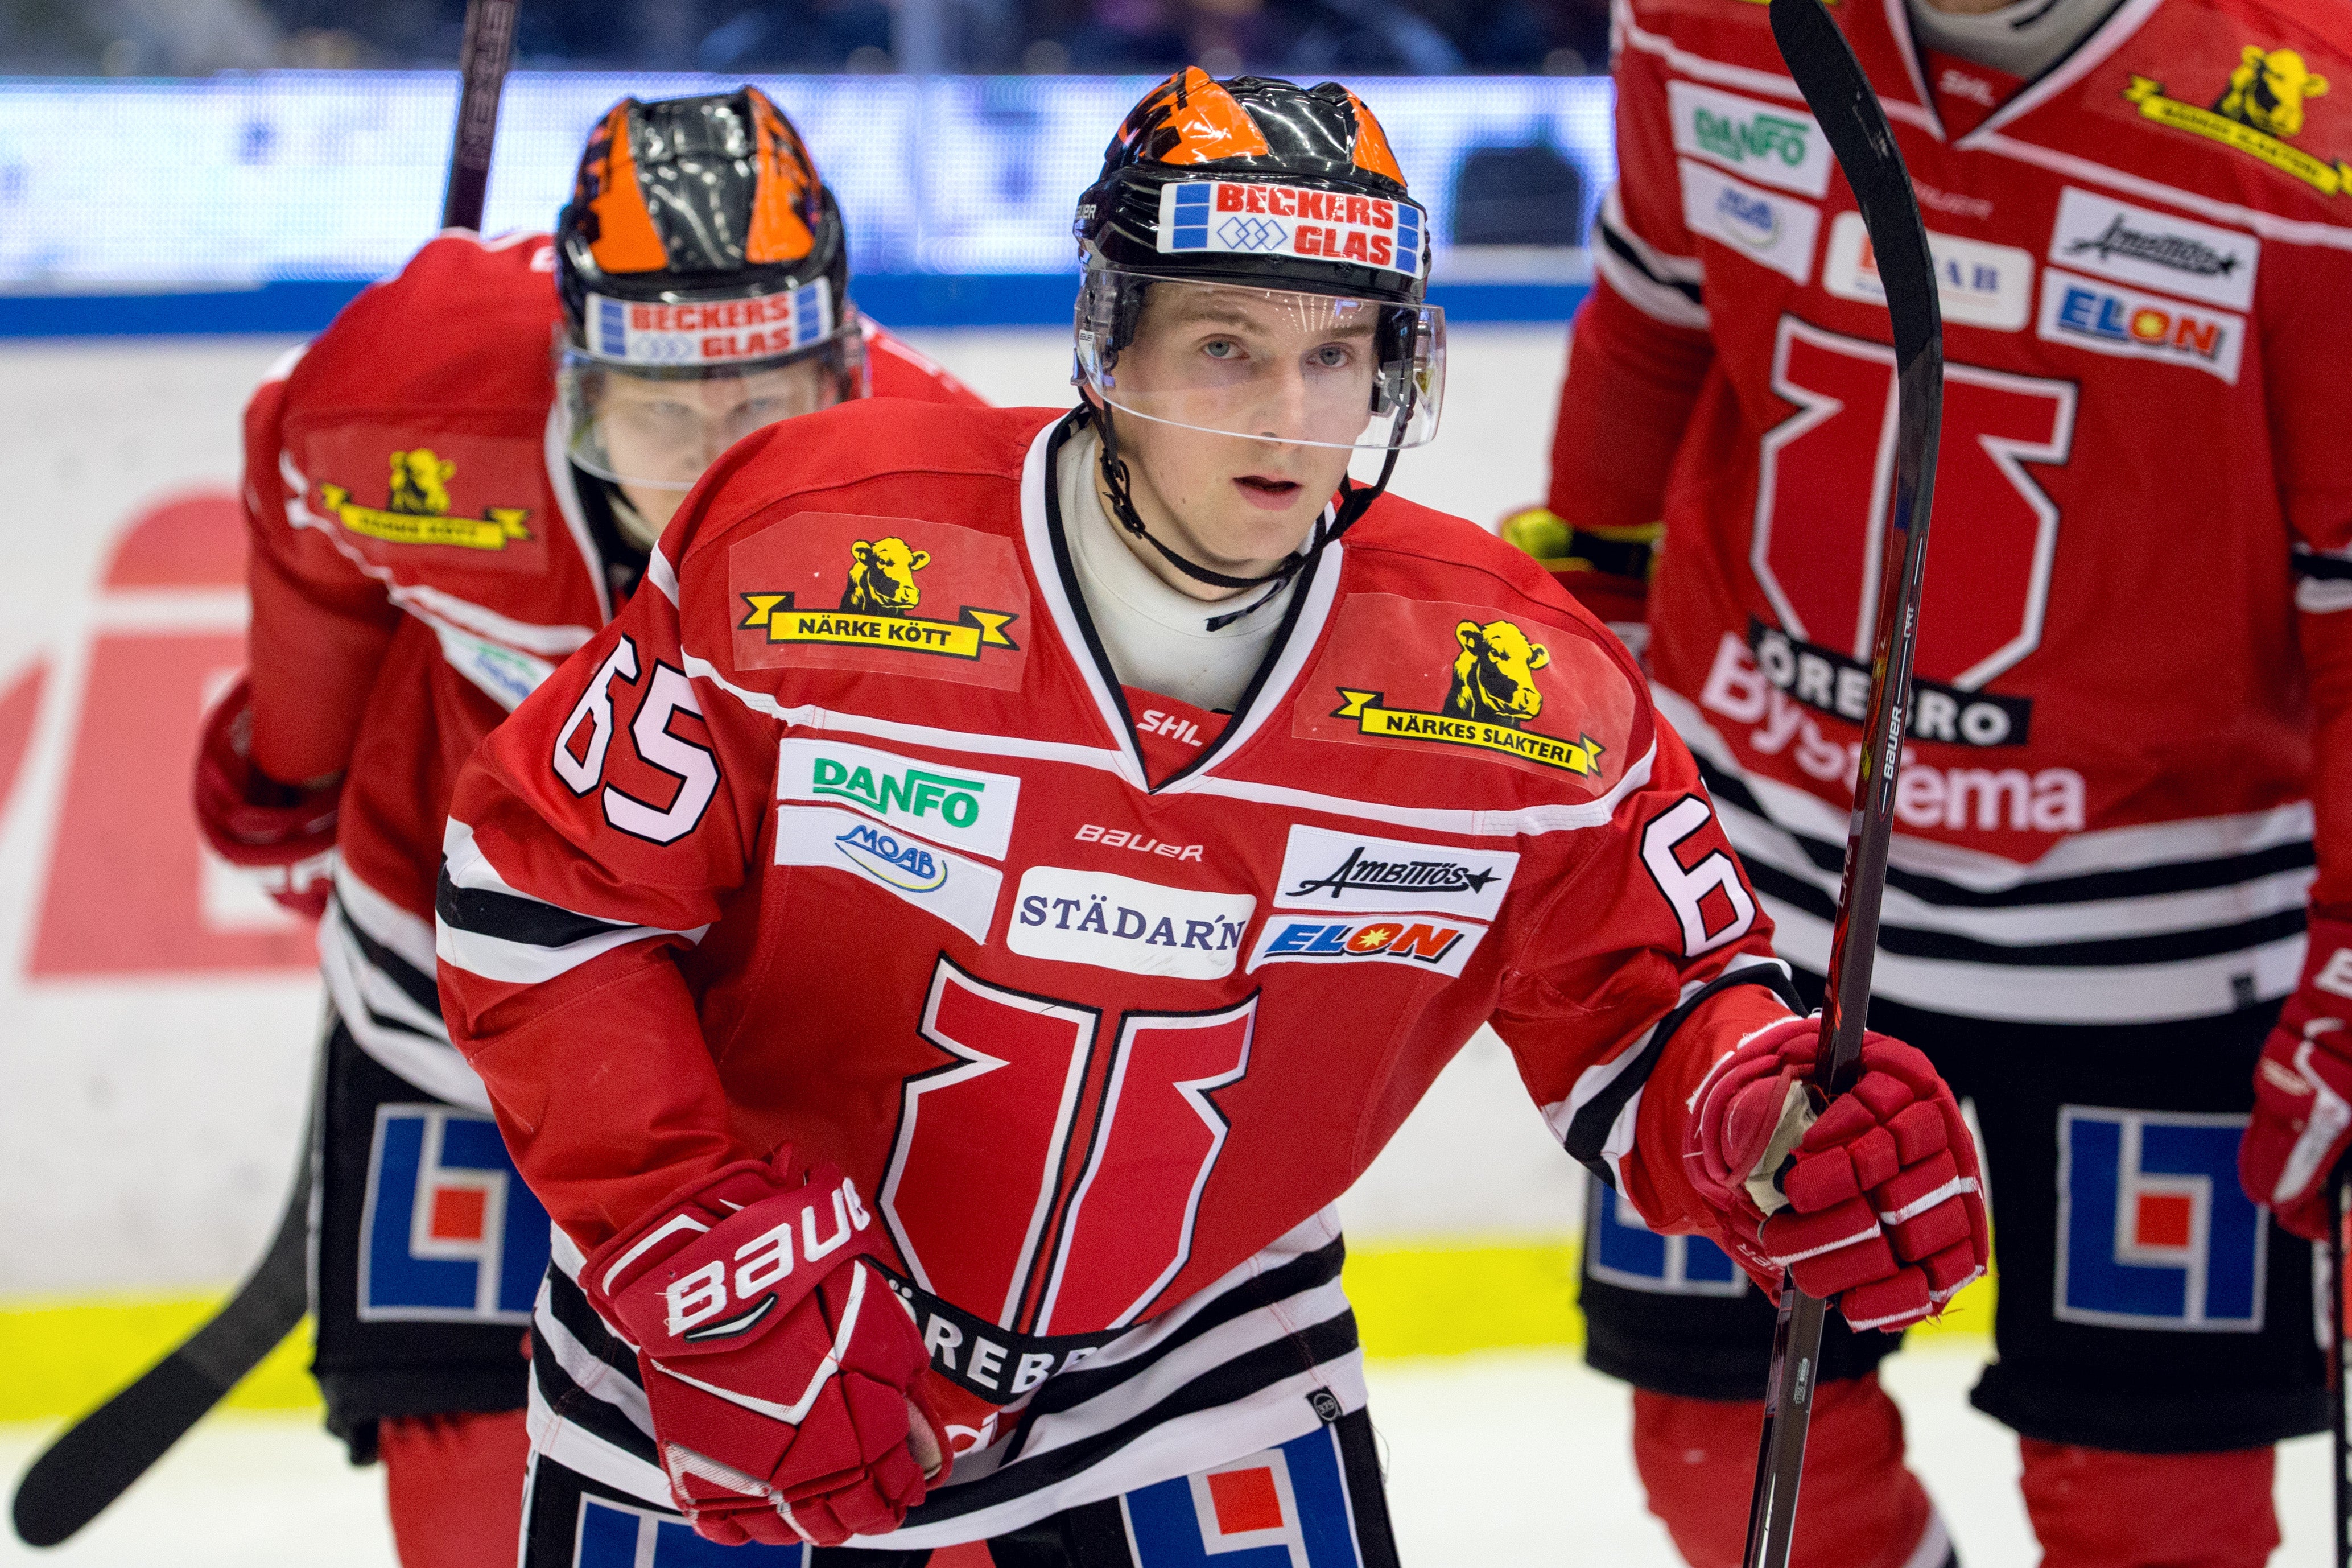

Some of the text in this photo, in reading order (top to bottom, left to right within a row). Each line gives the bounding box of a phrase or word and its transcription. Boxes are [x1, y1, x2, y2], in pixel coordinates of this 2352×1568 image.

[1216, 184, 1394, 230] BECKERS
[1293, 225, 1393, 266] GLAS
[630, 297, 789, 331] BECKERS
[2057, 284, 2226, 360] ELON
[702, 326, 791, 358] GLAS
[799, 614, 951, 646] NÄRKE KÖTT
[1757, 629, 2013, 746] ÖRERO
[552, 632, 721, 847] 65
[1136, 709, 1202, 746] SHL
[1387, 715, 1573, 764] NÄRKES SLAKTERI
[813, 758, 985, 828] DANFO
[836, 825, 935, 880] MOAB
[1639, 793, 1756, 957] 6
[1264, 922, 1464, 964] ELON
